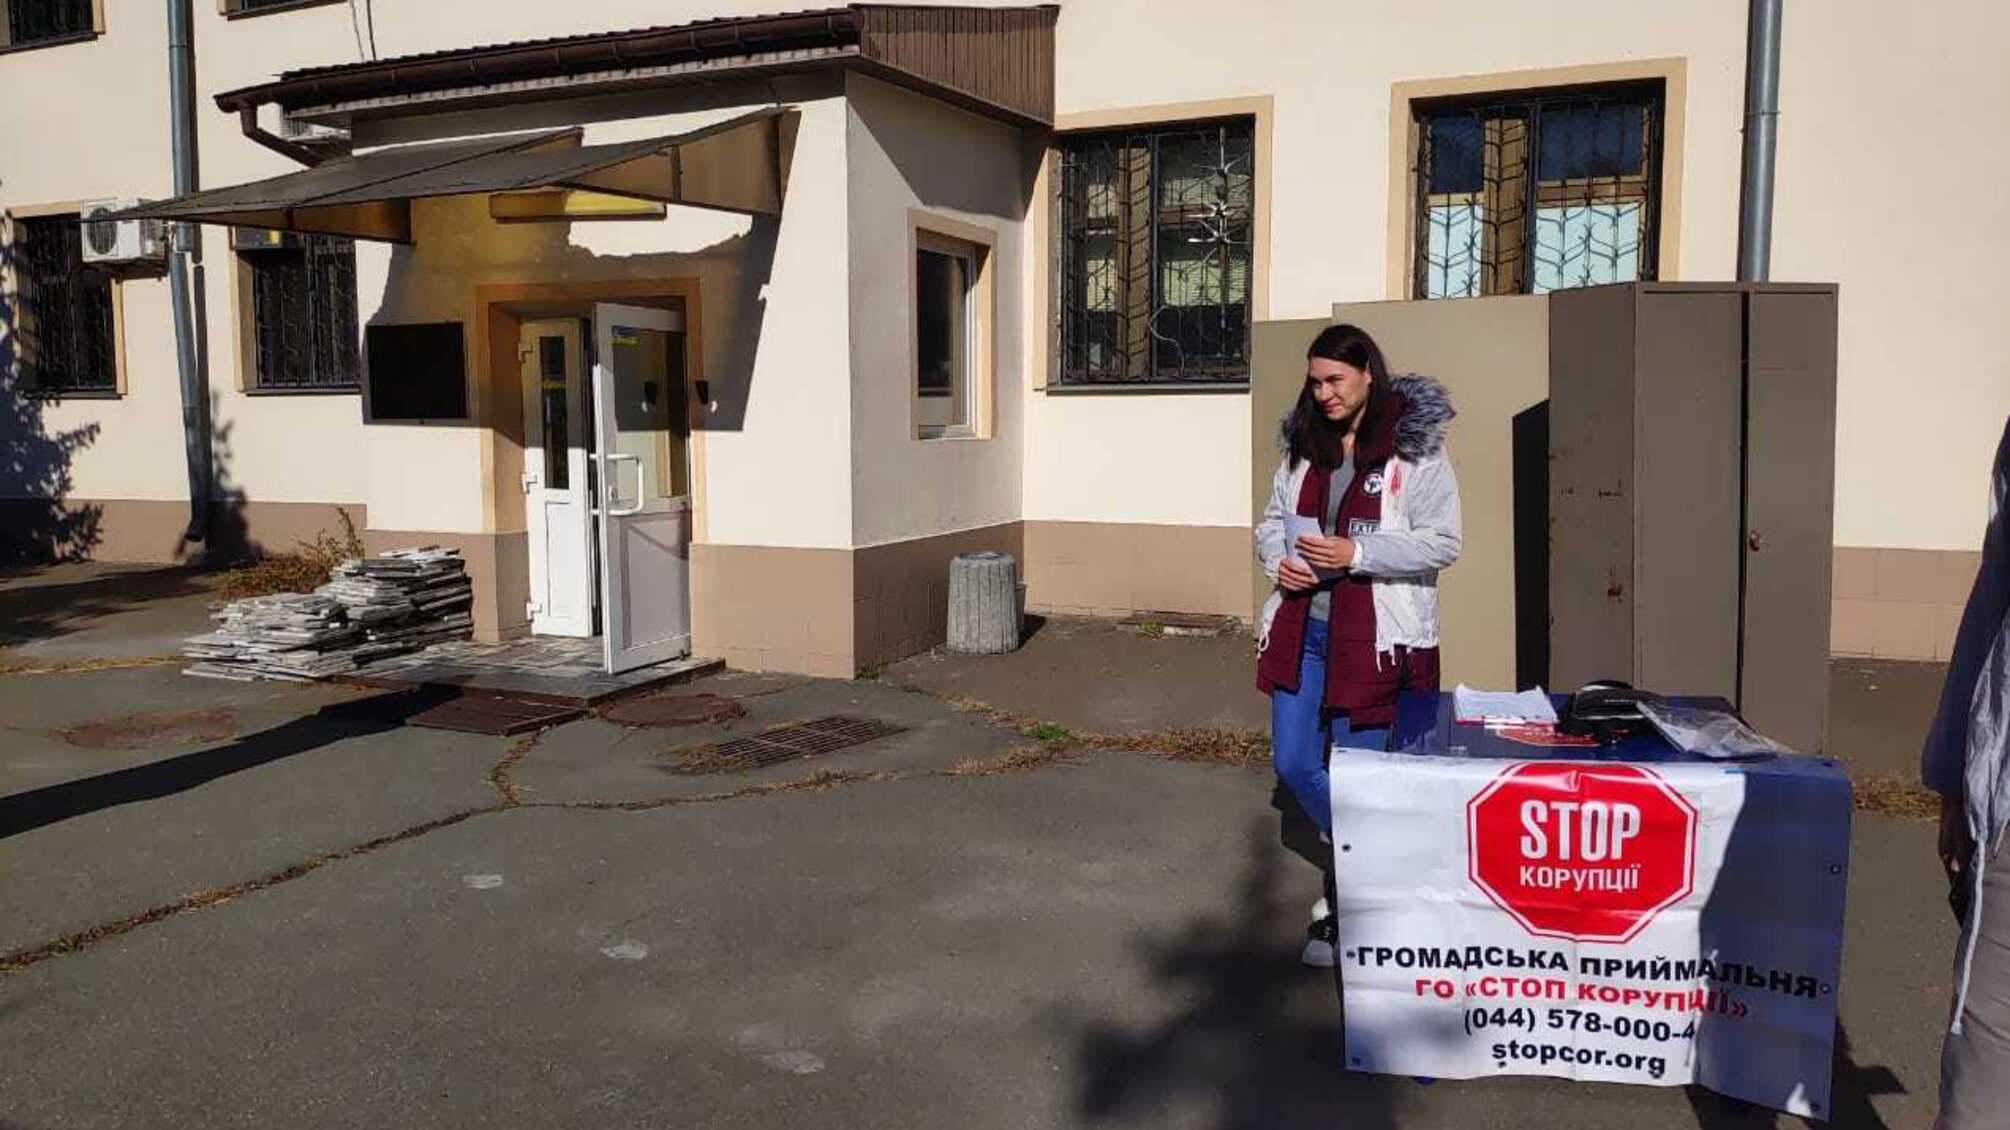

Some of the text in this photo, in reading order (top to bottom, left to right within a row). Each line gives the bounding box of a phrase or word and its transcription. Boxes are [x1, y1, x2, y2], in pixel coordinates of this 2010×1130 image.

[1520, 799, 1641, 862] STOP
[1520, 864, 1641, 892] КОРУПЦІЇ
[1357, 945, 1818, 999] ГРОМАДСЬКА ПРИЙМАЛЬНЯ
[1415, 976, 1748, 1018] ГО «СТОП КОРУПЦІЇ»
[1464, 1007, 1695, 1042] (044) 578-000-4
[1492, 1039, 1667, 1079] stopcor.org
